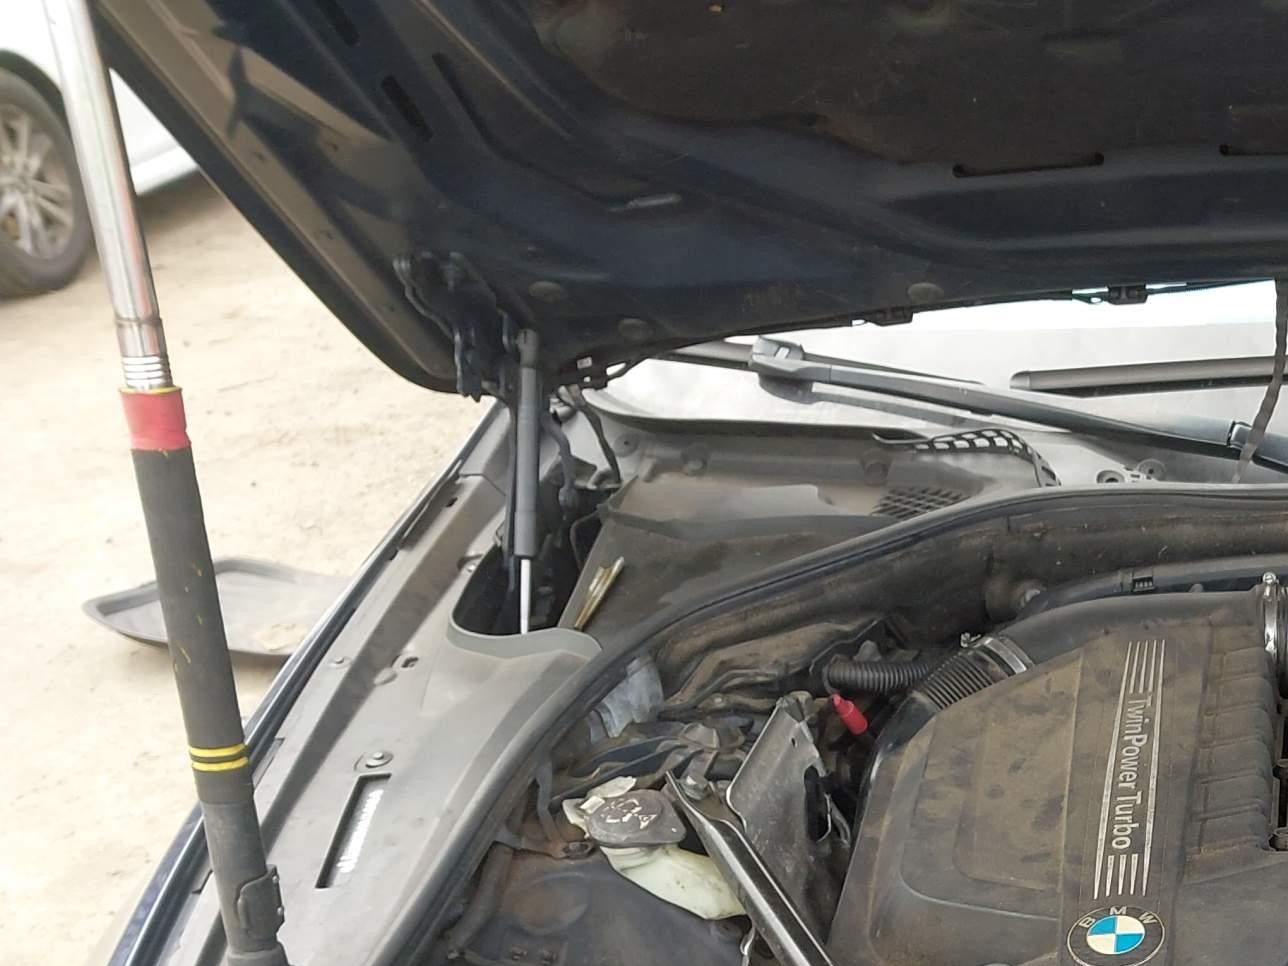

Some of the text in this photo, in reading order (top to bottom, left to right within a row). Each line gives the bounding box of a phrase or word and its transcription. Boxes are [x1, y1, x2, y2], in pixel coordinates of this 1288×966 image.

[1111, 693, 1153, 850] TwinPower Turbo
[1080, 906, 1159, 929] BMW
